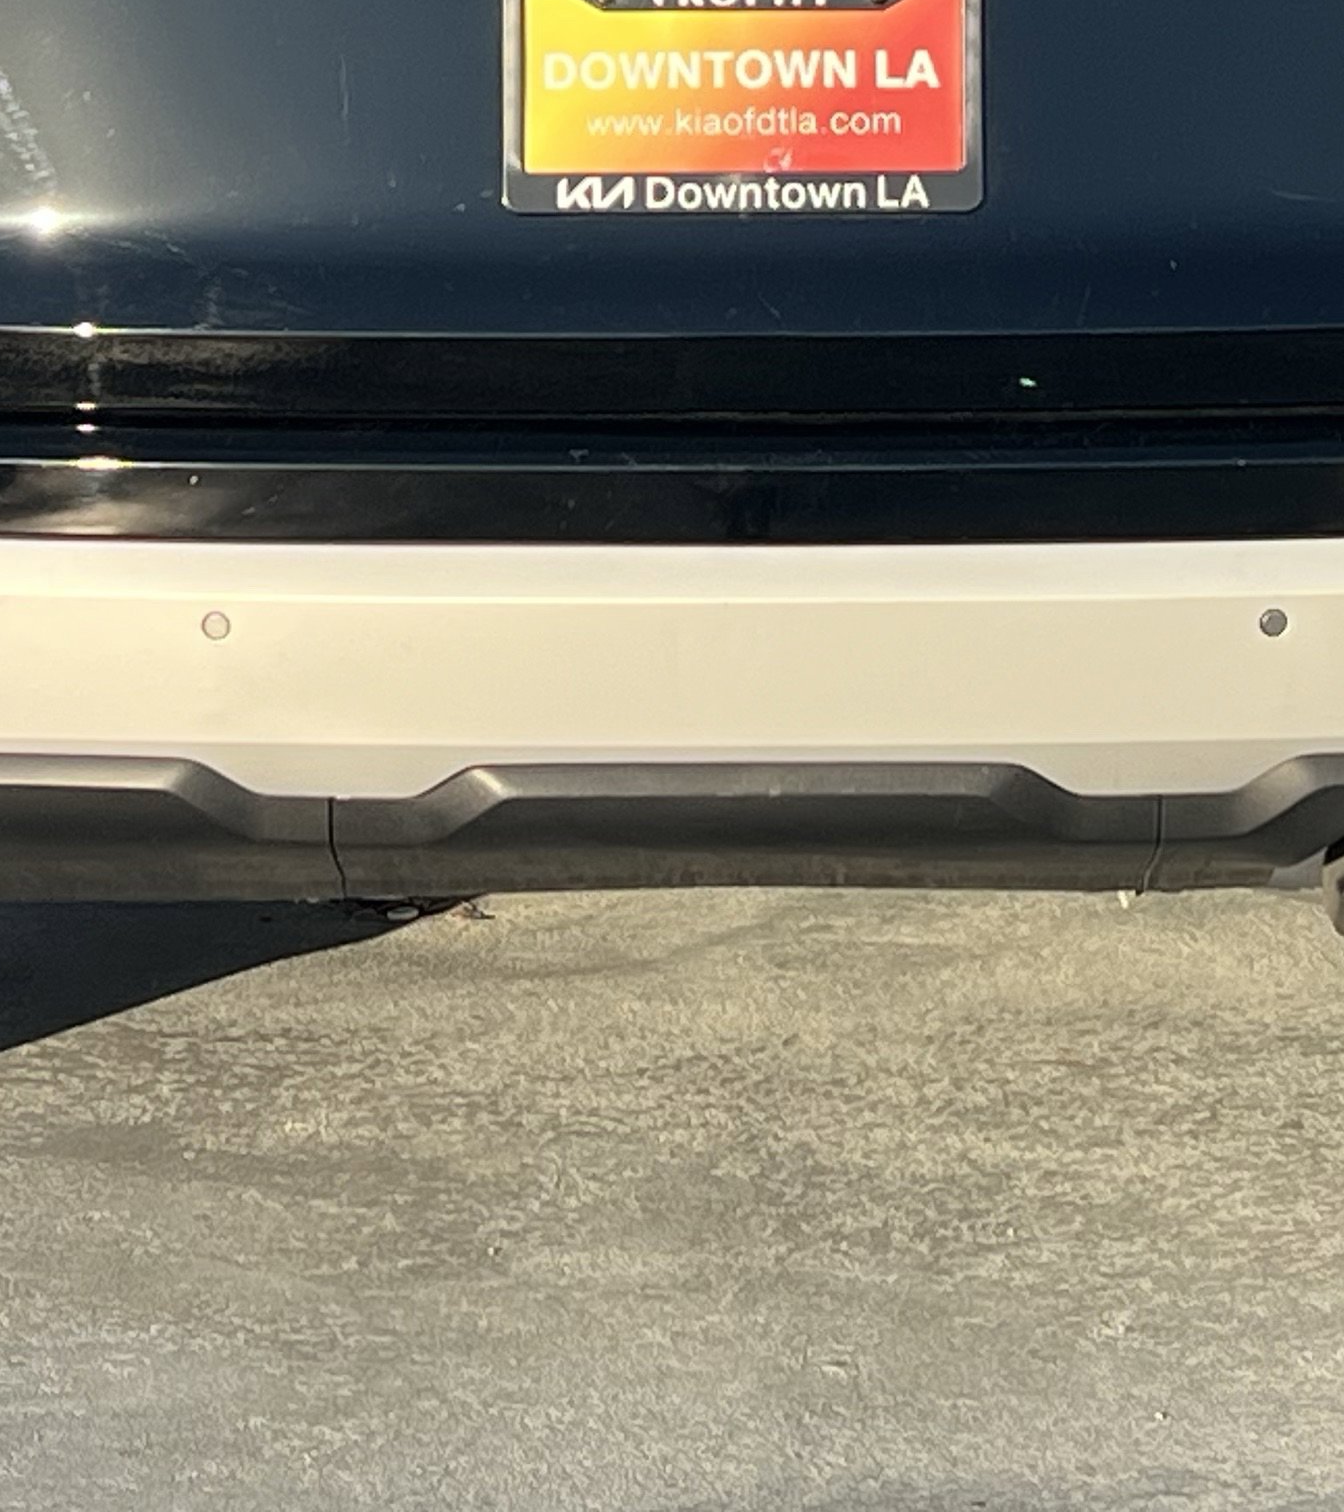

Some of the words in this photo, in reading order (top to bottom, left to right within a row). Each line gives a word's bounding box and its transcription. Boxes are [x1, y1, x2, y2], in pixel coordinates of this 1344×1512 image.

[542, 50, 856, 89] DOWNTOWN
[875, 49, 941, 89] LA
[586, 106, 902, 136] www.kiaofdtla.com
[556, 176, 636, 209] KIA
[646, 176, 866, 210] Downtown
[877, 175, 930, 209] LA
